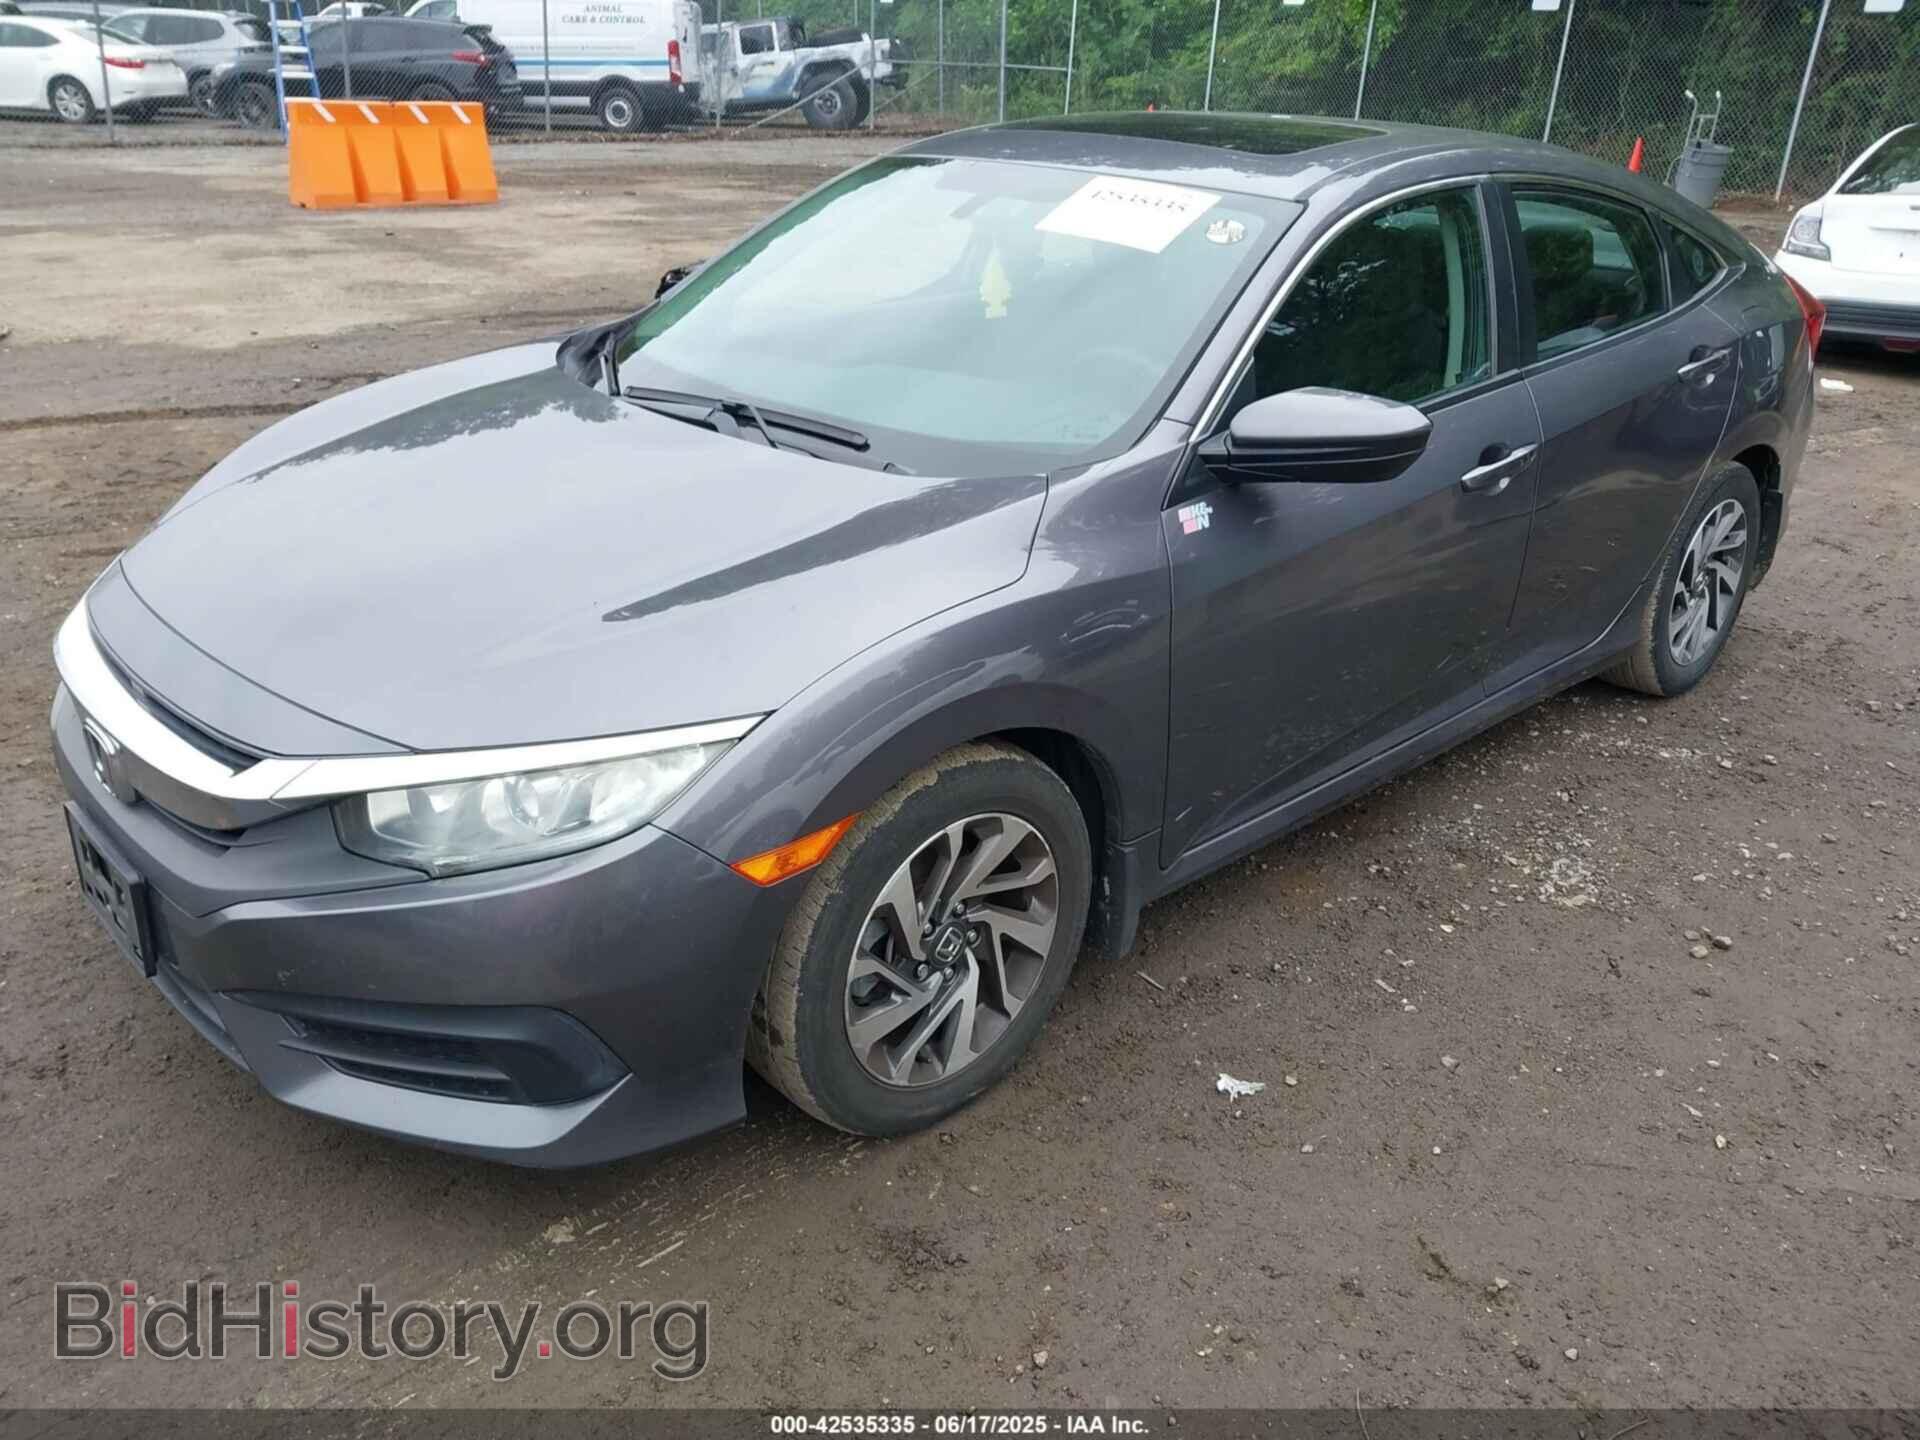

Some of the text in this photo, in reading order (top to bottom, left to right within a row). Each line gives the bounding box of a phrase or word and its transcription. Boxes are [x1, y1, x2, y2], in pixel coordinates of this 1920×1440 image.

[584, 4, 623, 13] ANIMAL
[562, 15, 587, 24] CARE
[600, 15, 646, 24] CONTROL
